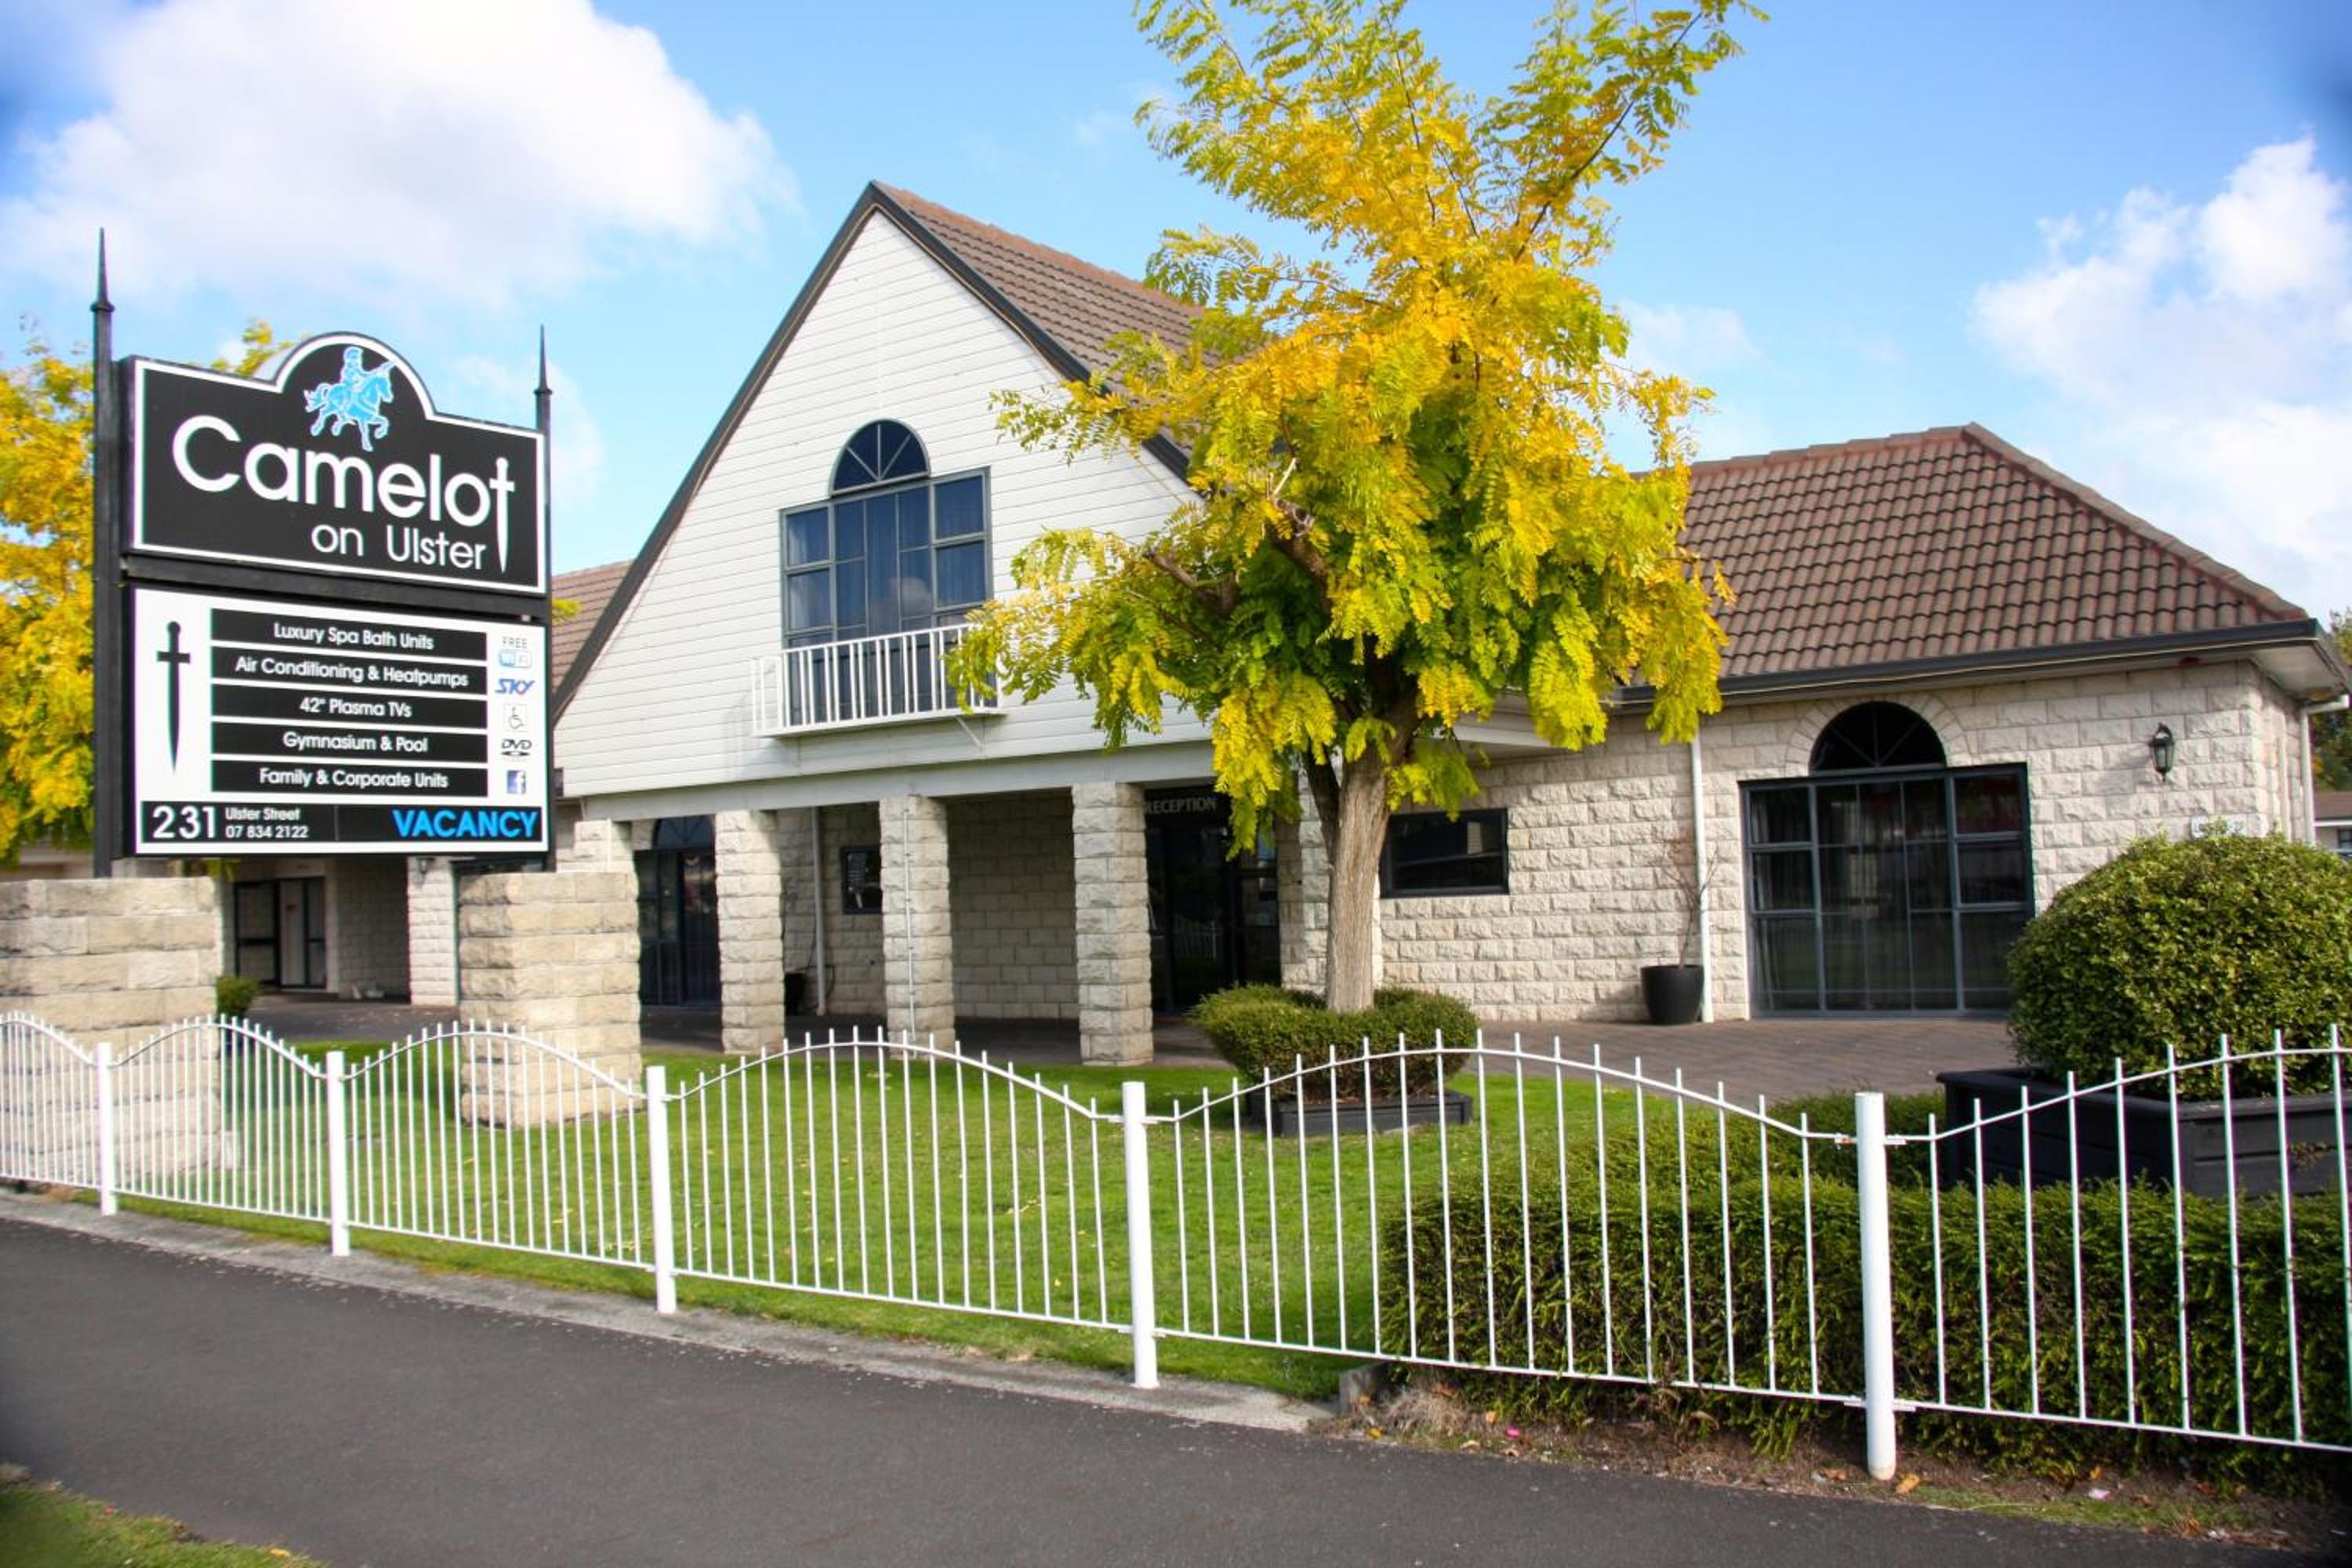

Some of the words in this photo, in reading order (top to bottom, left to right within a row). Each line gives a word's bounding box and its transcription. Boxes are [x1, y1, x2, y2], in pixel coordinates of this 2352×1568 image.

[172, 415, 515, 573] Camelot
[311, 524, 364, 556] on
[387, 524, 486, 570] Ulster
[274, 622, 325, 644] Luxury
[328, 626, 359, 645] Spa
[363, 630, 396, 647] Bath
[400, 633, 434, 650] Units
[501, 636, 528, 650] FREE
[235, 655, 258, 672] Air
[261, 657, 364, 683] Conditioning
[368, 666, 379, 681] &
[383, 666, 469, 688] Heatpumps
[495, 679, 535, 695] SKY
[328, 699, 384, 717] Plasma
[388, 702, 412, 717] TVs
[282, 731, 376, 750] Gymnasium
[380, 735, 393, 750] &
[395, 737, 429, 753] Pool
[500, 739, 532, 750] DVD
[260, 768, 311, 787] Family
[316, 769, 328, 785] &
[332, 771, 411, 789] Corporate
[415, 772, 448, 788] Units
[152, 805, 216, 839] 231
[225, 807, 260, 821] Ulster
[263, 807, 301, 821] Street
[393, 809, 539, 837] VACANCY
[225, 825, 243, 838] 07
[247, 825, 272, 838] 834
[275, 825, 309, 838] 2122
